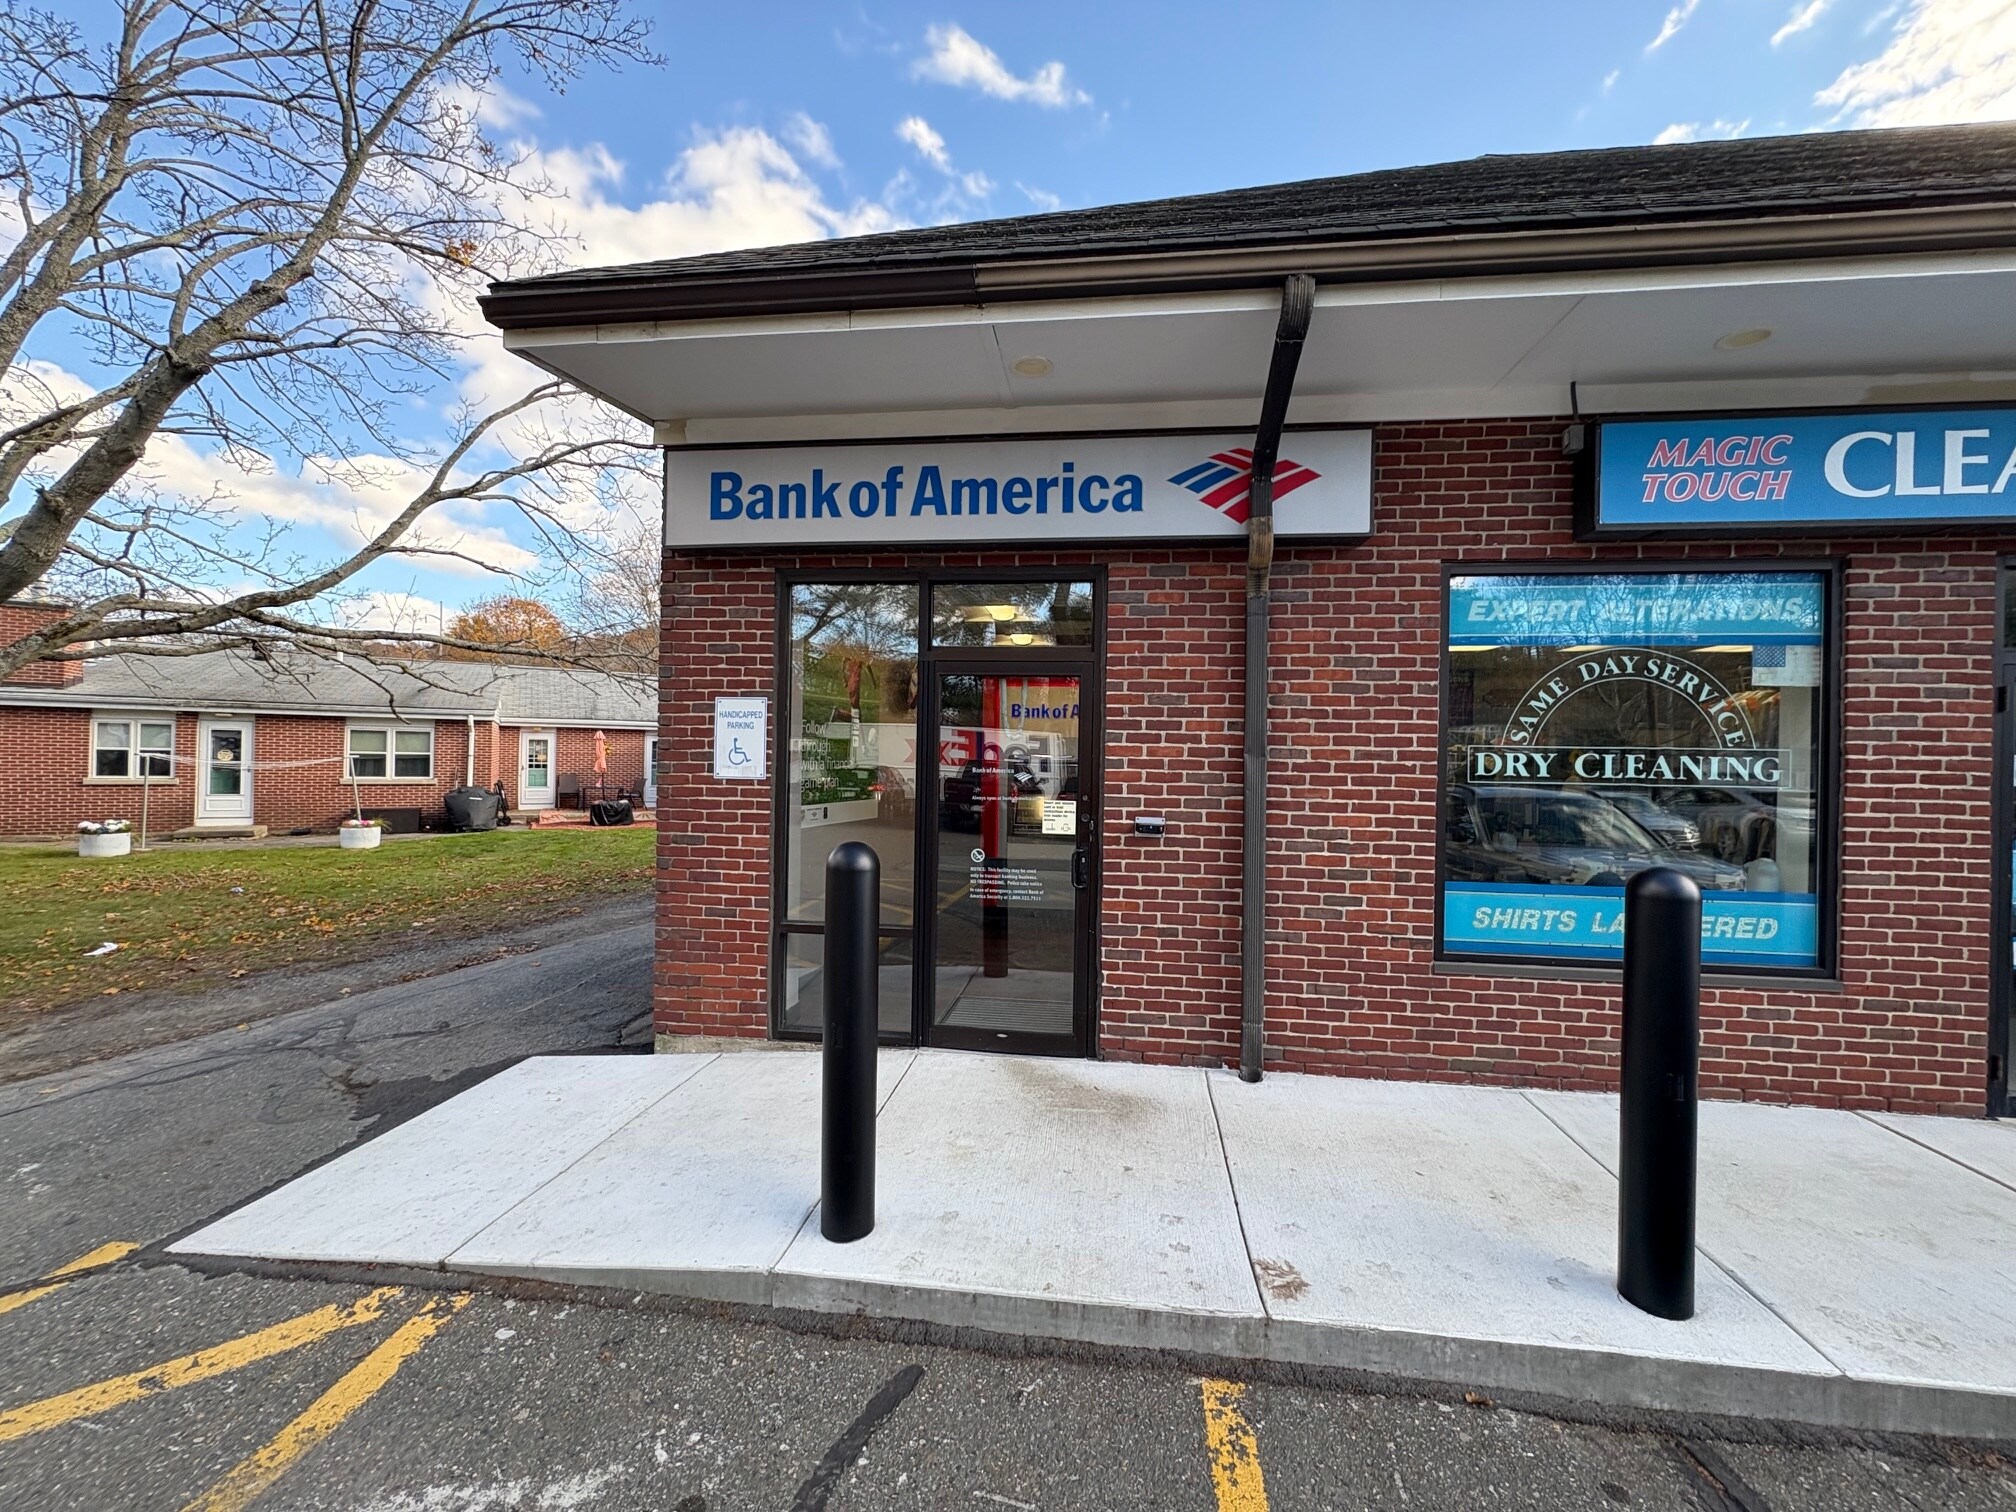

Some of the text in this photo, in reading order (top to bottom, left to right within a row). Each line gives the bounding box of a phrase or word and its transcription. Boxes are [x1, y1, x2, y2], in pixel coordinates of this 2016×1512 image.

[1647, 434, 1794, 468] MAGIC
[709, 461, 1144, 521] Bank of America
[1642, 470, 1793, 503] TOUCH
[1467, 597, 1804, 622] EXPERT ALTERATIONS
[719, 710, 763, 719] HANDICAPPED
[1011, 703, 1050, 718] Bank
[1053, 703, 1069, 719] of
[1510, 655, 1746, 748] SAME DAY SERVICE
[727, 721, 755, 730] PARKING
[801, 720, 827, 734] Follow
[1475, 751, 1783, 784] DRY CLEANING
[1472, 906, 1779, 940] SHIRTS LAERED
